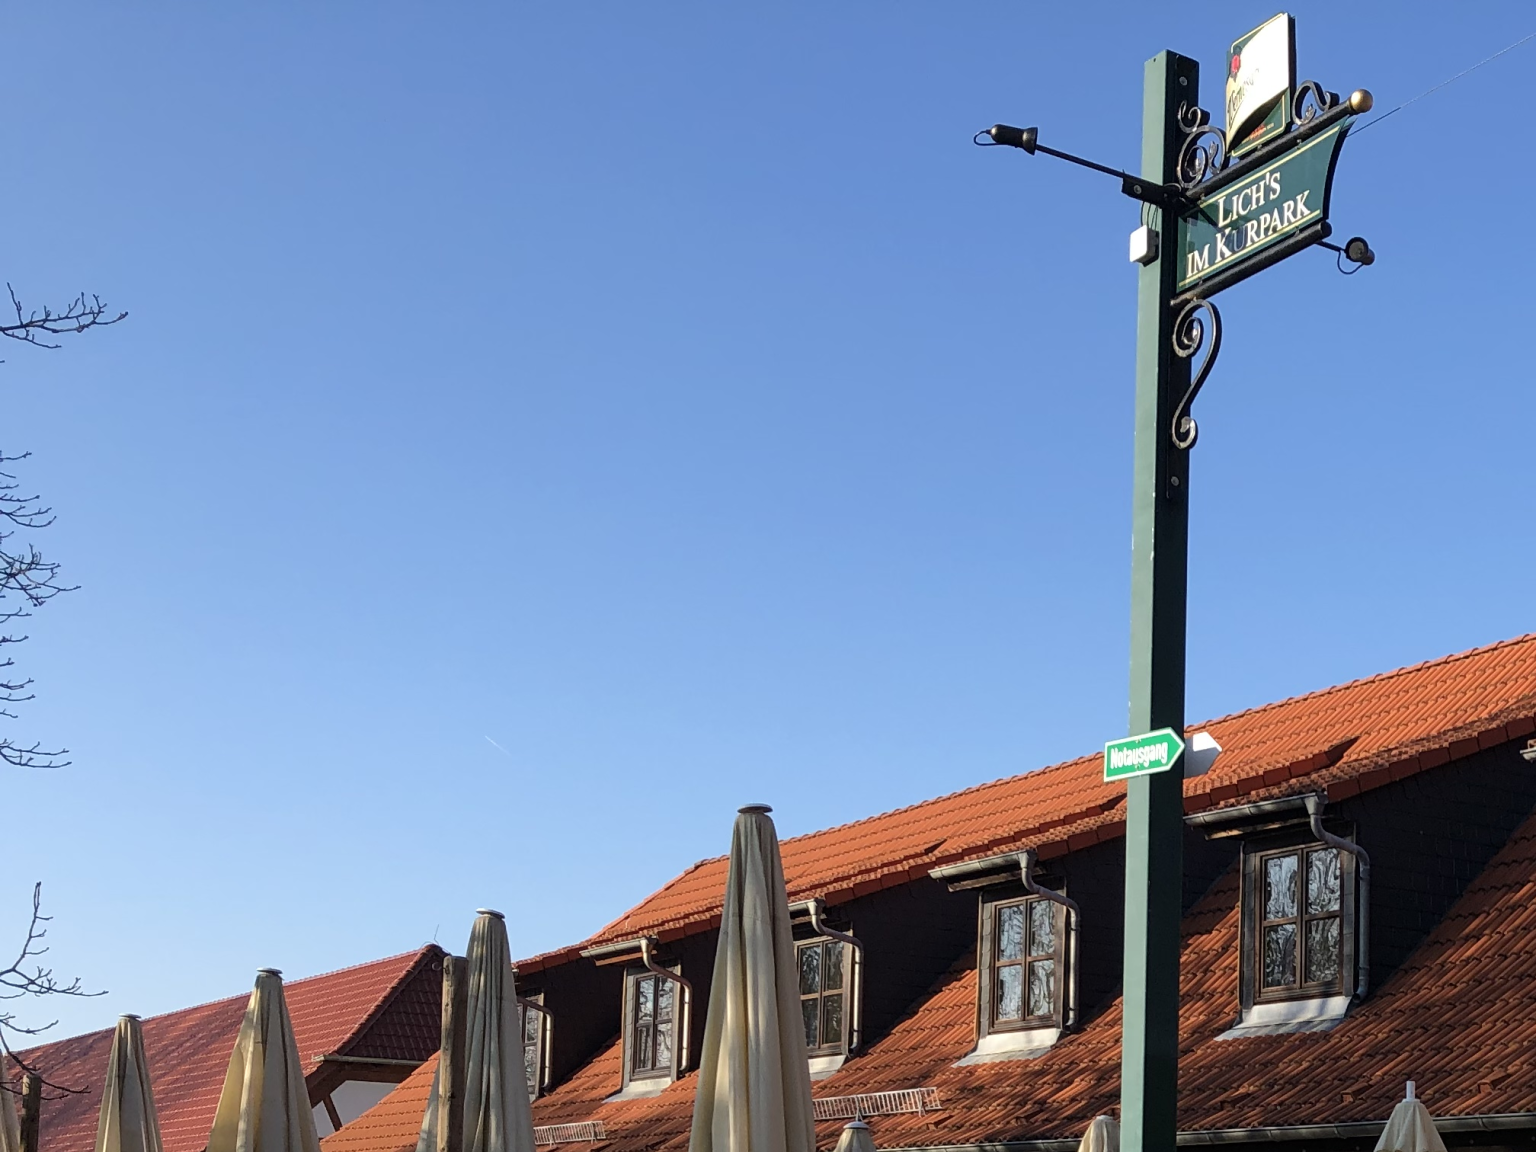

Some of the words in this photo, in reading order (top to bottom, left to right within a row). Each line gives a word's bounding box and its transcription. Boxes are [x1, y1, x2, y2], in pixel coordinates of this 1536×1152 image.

[1218, 171, 1281, 228] LICH'S
[1186, 243, 1211, 278] IM
[1214, 189, 1311, 263] KURPARK
[1110, 741, 1169, 770] Notausgang
